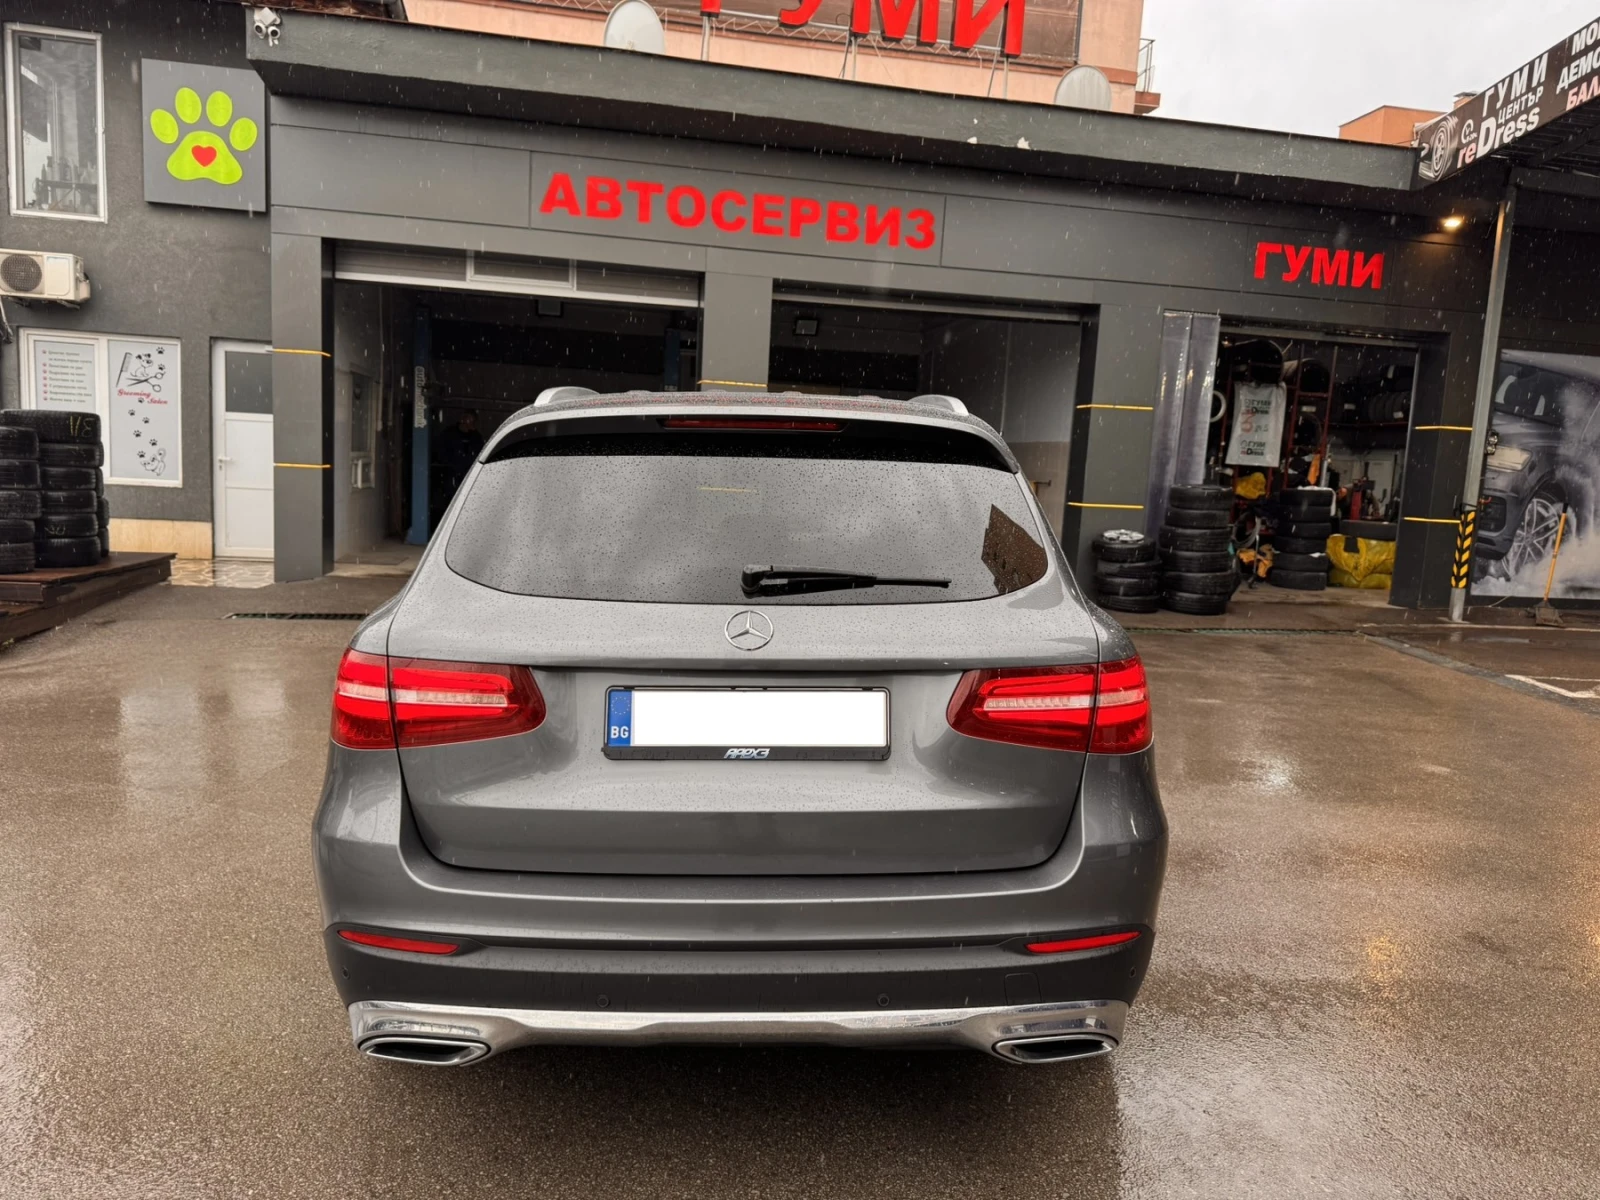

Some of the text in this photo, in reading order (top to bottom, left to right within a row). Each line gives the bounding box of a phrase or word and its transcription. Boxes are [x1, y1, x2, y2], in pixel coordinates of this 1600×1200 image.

[1571, 17, 1600, 55] МО
[1482, 52, 1549, 118] ГУМИ
[1498, 86, 1544, 125] ЦЕНТЪР
[1457, 107, 1540, 169] reDress
[540, 172, 936, 251] АВТОСЕРВИЗ
[1253, 242, 1384, 290] ГУМИ
[117, 388, 151, 399] Grooming
[611, 725, 629, 739] BG
